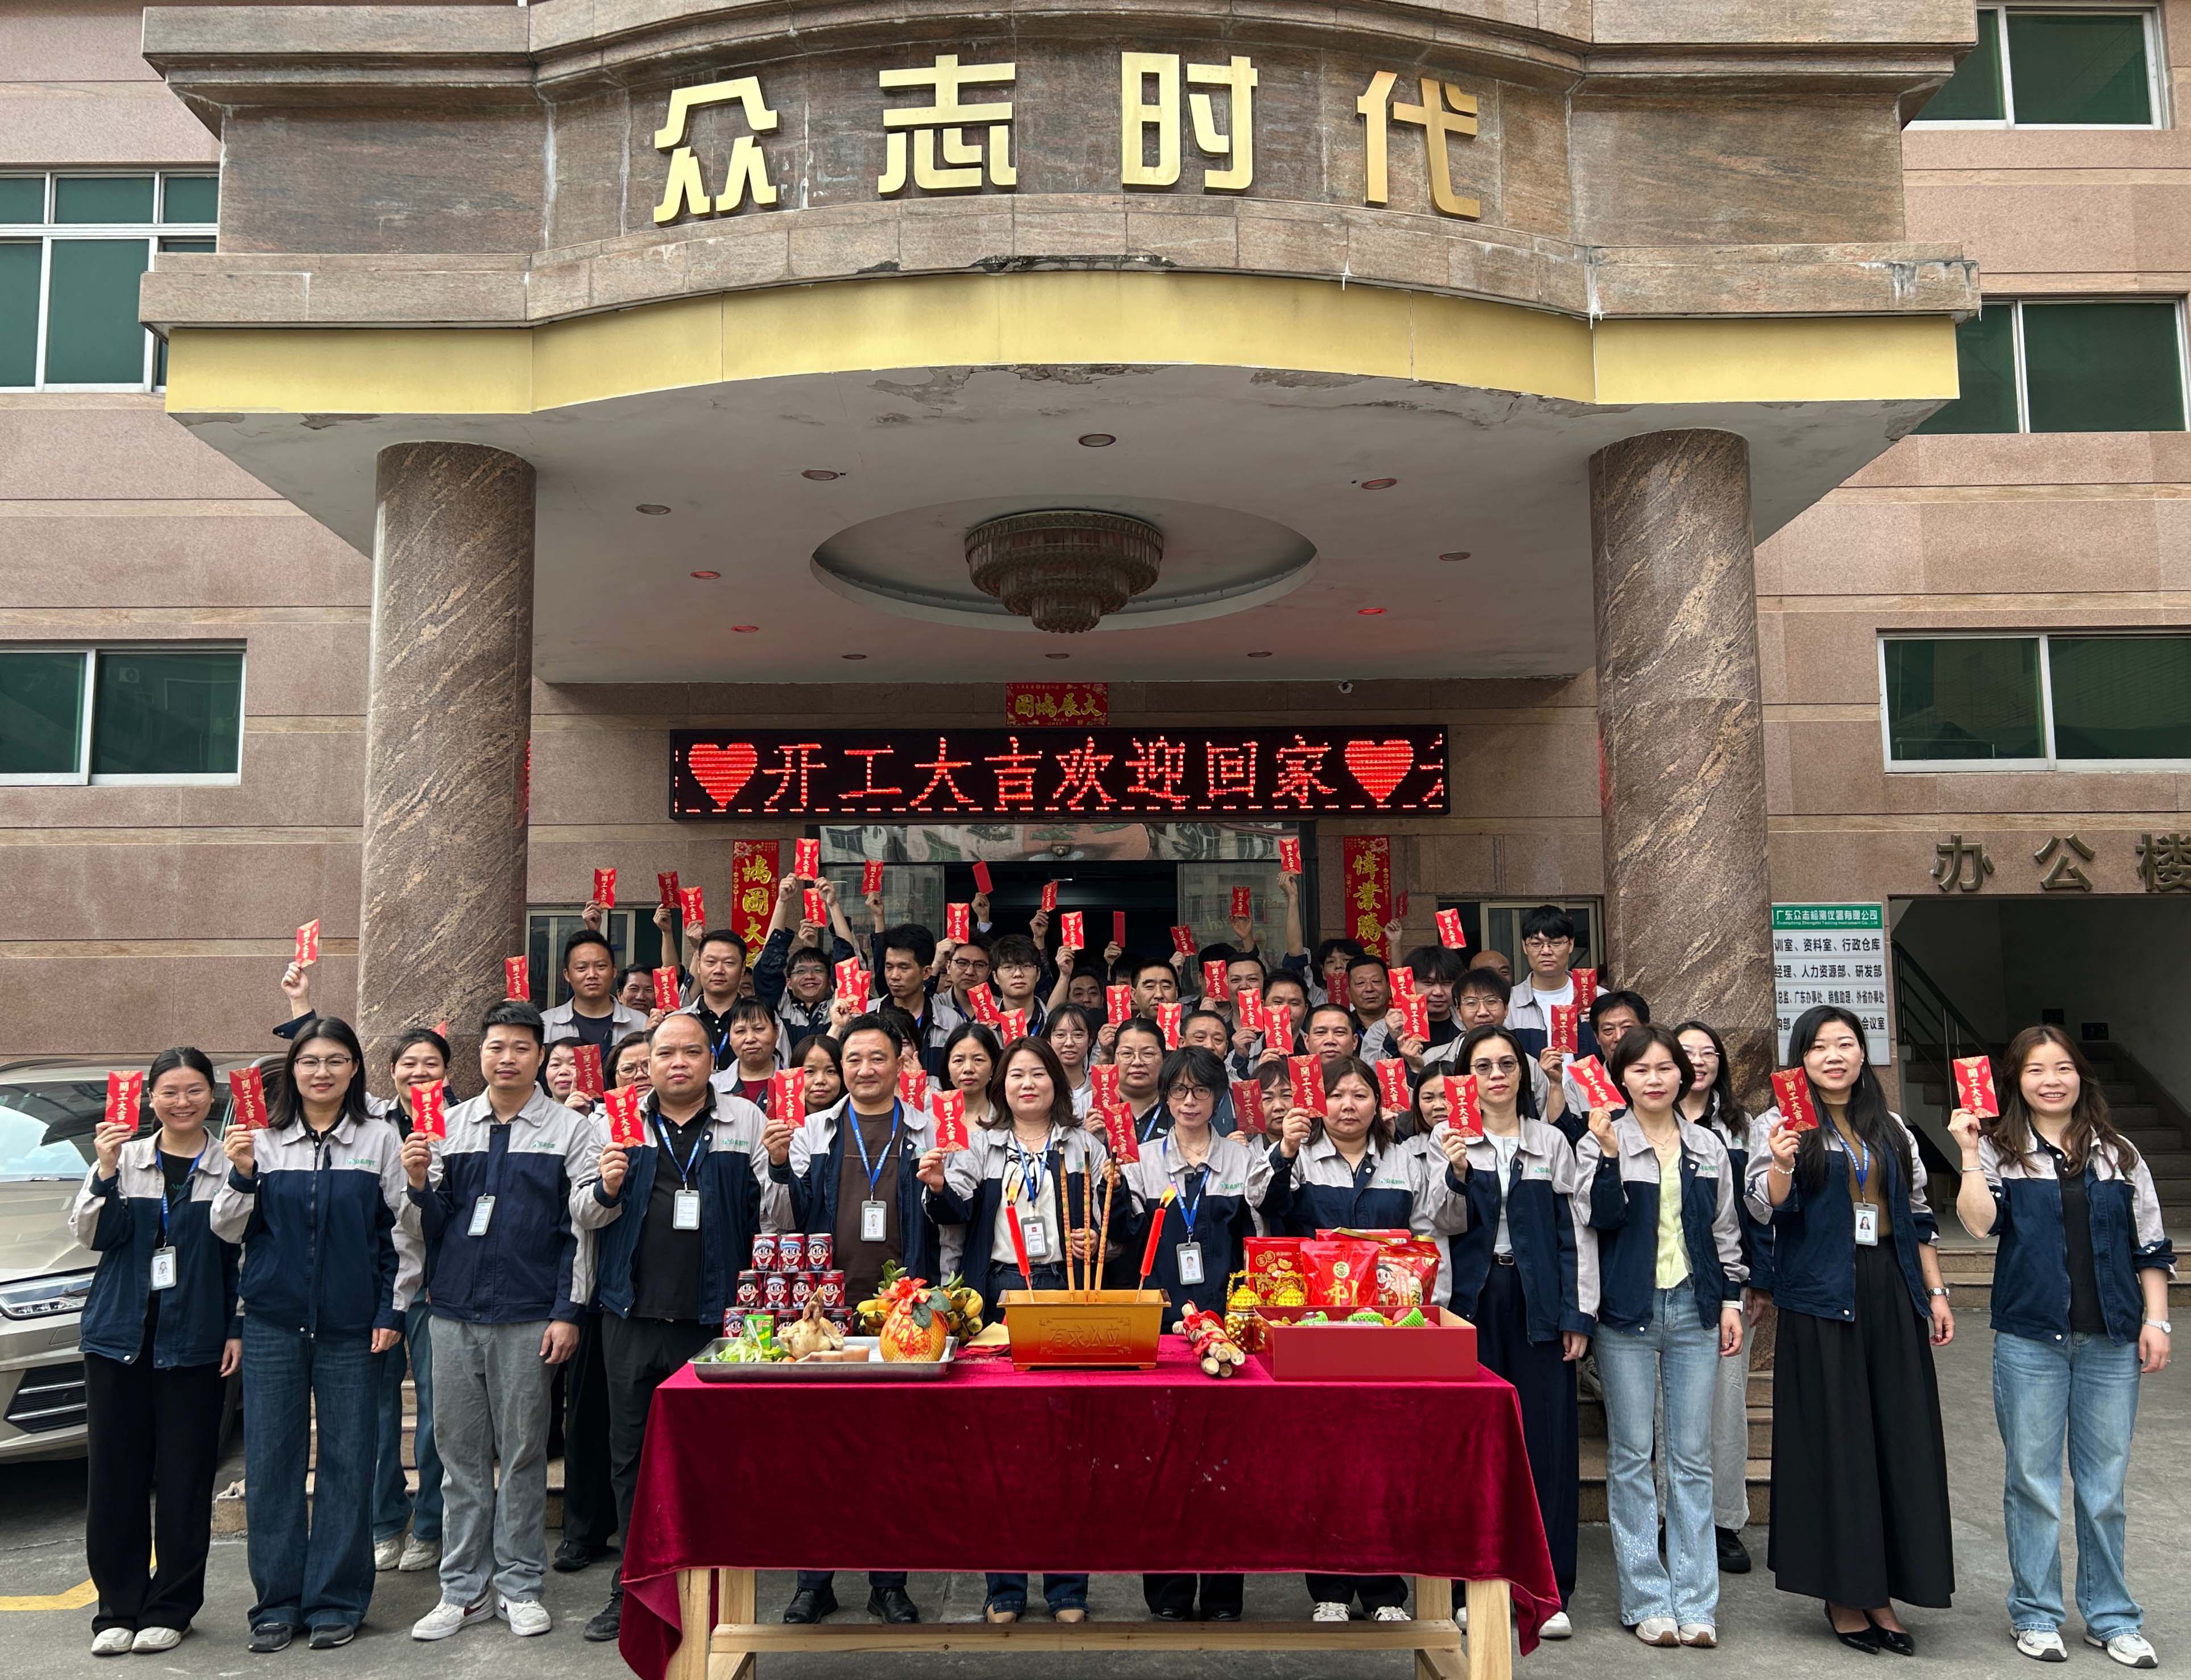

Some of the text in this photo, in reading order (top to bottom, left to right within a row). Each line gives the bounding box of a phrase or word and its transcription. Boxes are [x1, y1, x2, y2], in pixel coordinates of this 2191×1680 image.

[654, 52, 1478, 225] 众志时代
[762, 734, 1337, 807] 开工大吉欢迎回家
[802, 847, 811, 872] 開工大吉
[1932, 833, 2191, 891] 办公楼
[688, 894, 697, 920] 開工大吉
[810, 895, 819, 921] 開工大吉
[1776, 910, 1878, 920] 广东众志检测仪器有限公司
[1444, 916, 1456, 942] 開工大吉
[302, 930, 310, 960] 開工大吉
[1774, 938, 1881, 952] 训室、资料室、行政仓库
[512, 965, 521, 994] 開工大吉
[843, 968, 853, 994] 開工大吉
[1212, 968, 1221, 994] 開工大吉
[1397, 976, 1407, 995] 開工大
[1774, 965, 1882, 978] 经理、人力资源部、研发部
[661, 976, 670, 1004] 開工大吉
[1776, 990, 1884, 1004] 总监、广东办事处、销售助理、外省办事处
[976, 994, 990, 1019] 開工大吉
[1115, 994, 1123, 1021] 開工大吉
[1246, 997, 1254, 1024] 開工大吉
[1410, 1003, 1420, 1033] 開工大吉
[1273, 1015, 1283, 1045] 開工大吉
[1559, 1014, 1568, 1043] 開工大吉
[1861, 1017, 1885, 1030] 会议室
[241, 1079, 255, 1119] 開工大吉
[785, 1079, 794, 1118] 開工大吉
[908, 1078, 917, 1107] 開工大
[1101, 1074, 1109, 1106] 開工大吉
[1300, 1067, 1314, 1106] 開工大吉
[1386, 1069, 1399, 1102] 開工大吉
[1583, 1069, 1608, 1102] 開工大吉
[1967, 1068, 1983, 1106] 開工大吉
[117, 1082, 129, 1121] 開工大吉
[422, 1093, 433, 1131] 開工大吉
[1456, 1087, 1469, 1126] 開工大吉
[1786, 1082, 1803, 1120] 開工大吉
[616, 1097, 631, 1136] 開工大吉
[943, 1102, 955, 1140] 開工大吉
[1113, 1115, 1128, 1153] 開工大吉
[1049, 1324, 1121, 1350] 有求必应
